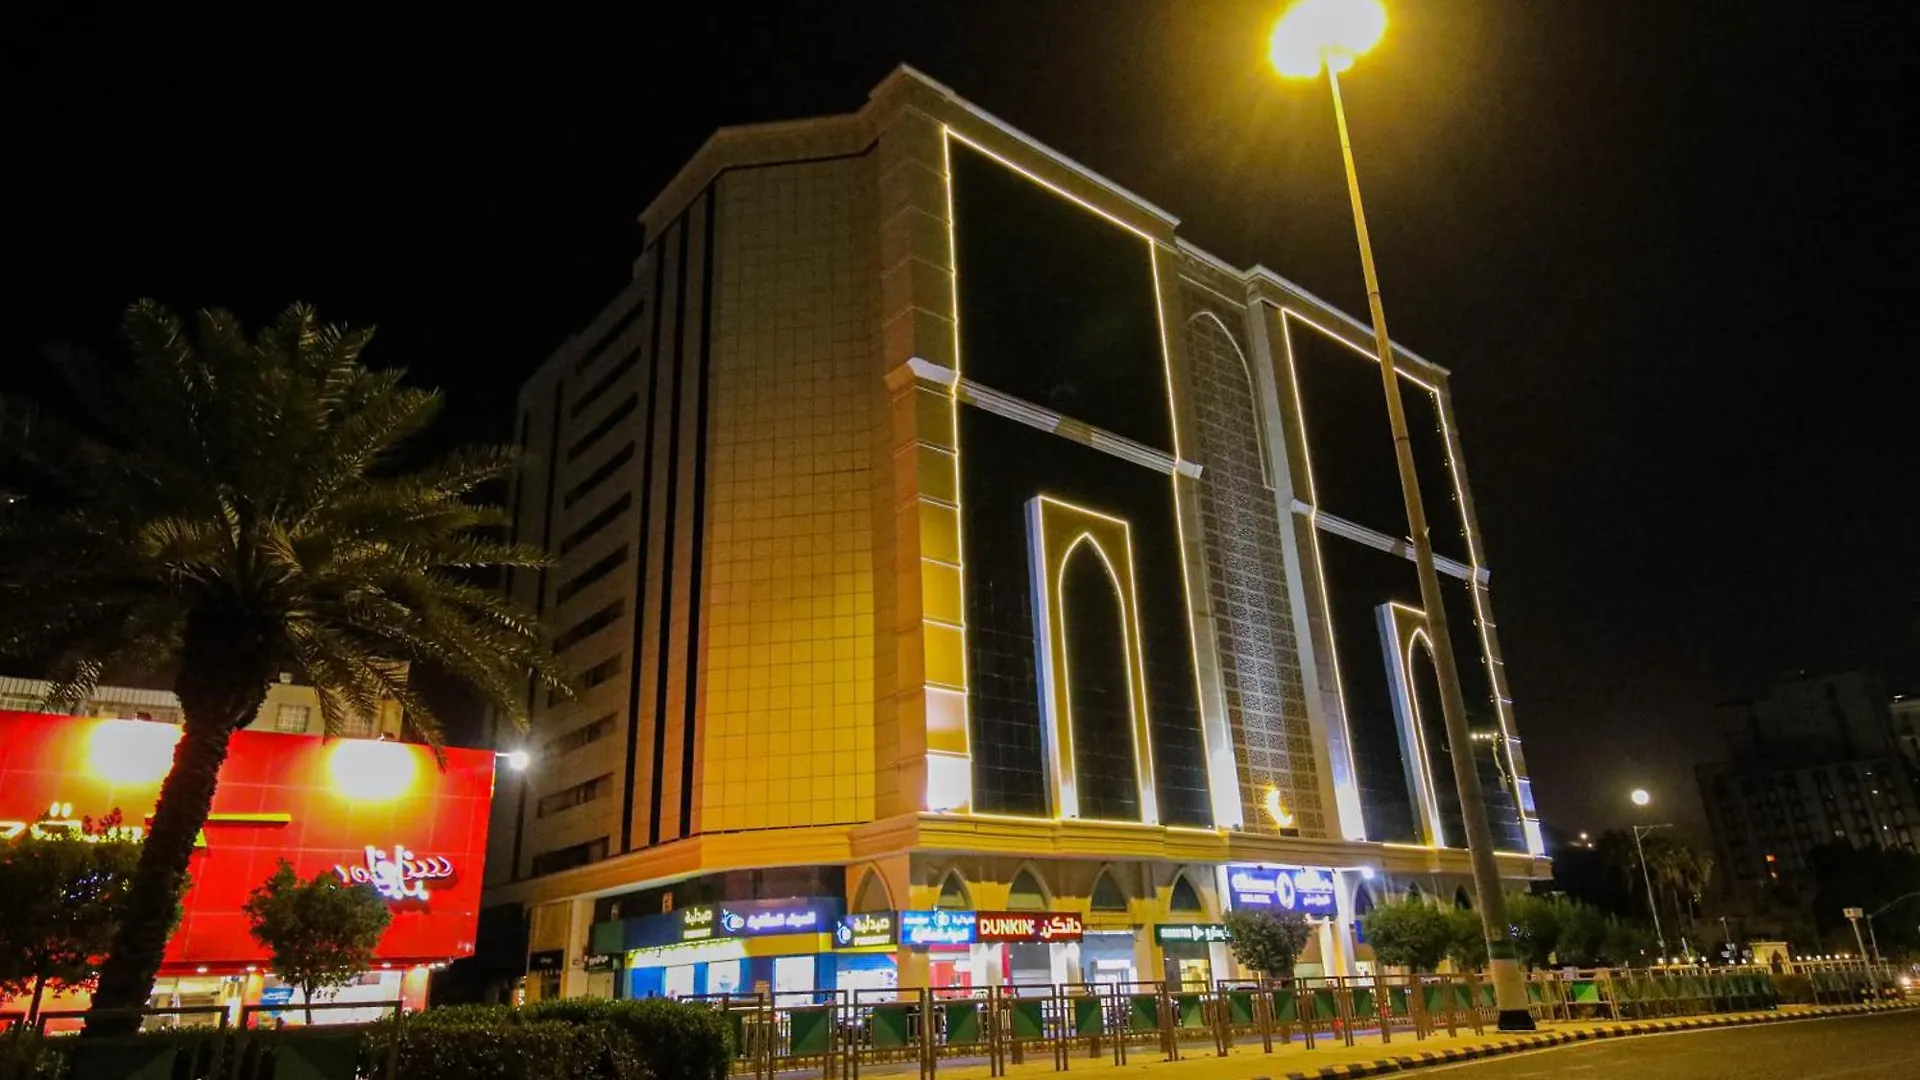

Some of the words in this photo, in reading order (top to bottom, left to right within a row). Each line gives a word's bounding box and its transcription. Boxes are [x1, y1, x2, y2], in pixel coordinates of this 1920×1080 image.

[685, 907, 712, 926] صيدلية
[854, 915, 890, 933] صيدلية
[1040, 916, 1082, 939] دانكن
